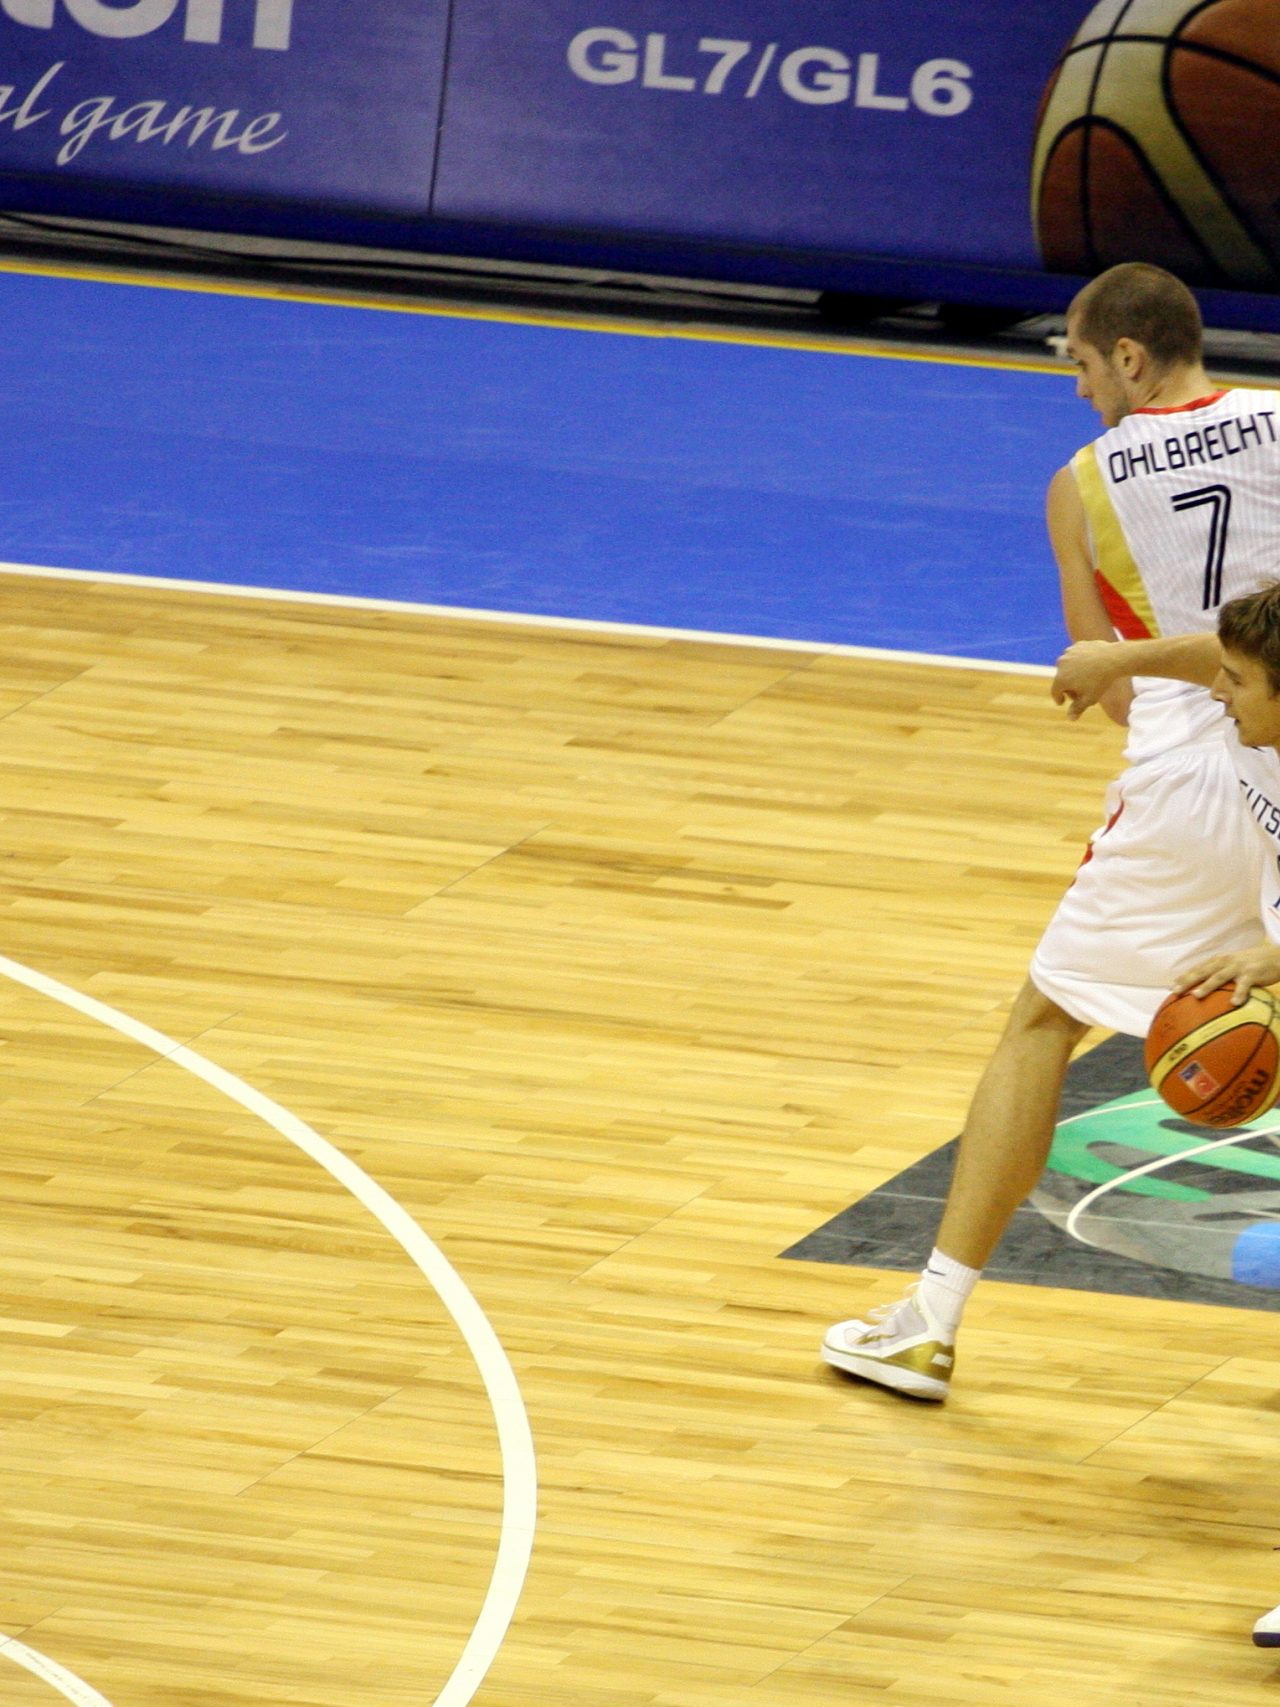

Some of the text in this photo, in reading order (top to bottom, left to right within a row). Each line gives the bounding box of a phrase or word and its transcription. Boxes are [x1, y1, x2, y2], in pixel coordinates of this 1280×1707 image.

[567, 27, 973, 117] GL7/GL6
[56, 96, 289, 166] game
[1108, 411, 1277, 484] OHLBRECHT
[1170, 484, 1232, 611] 7
